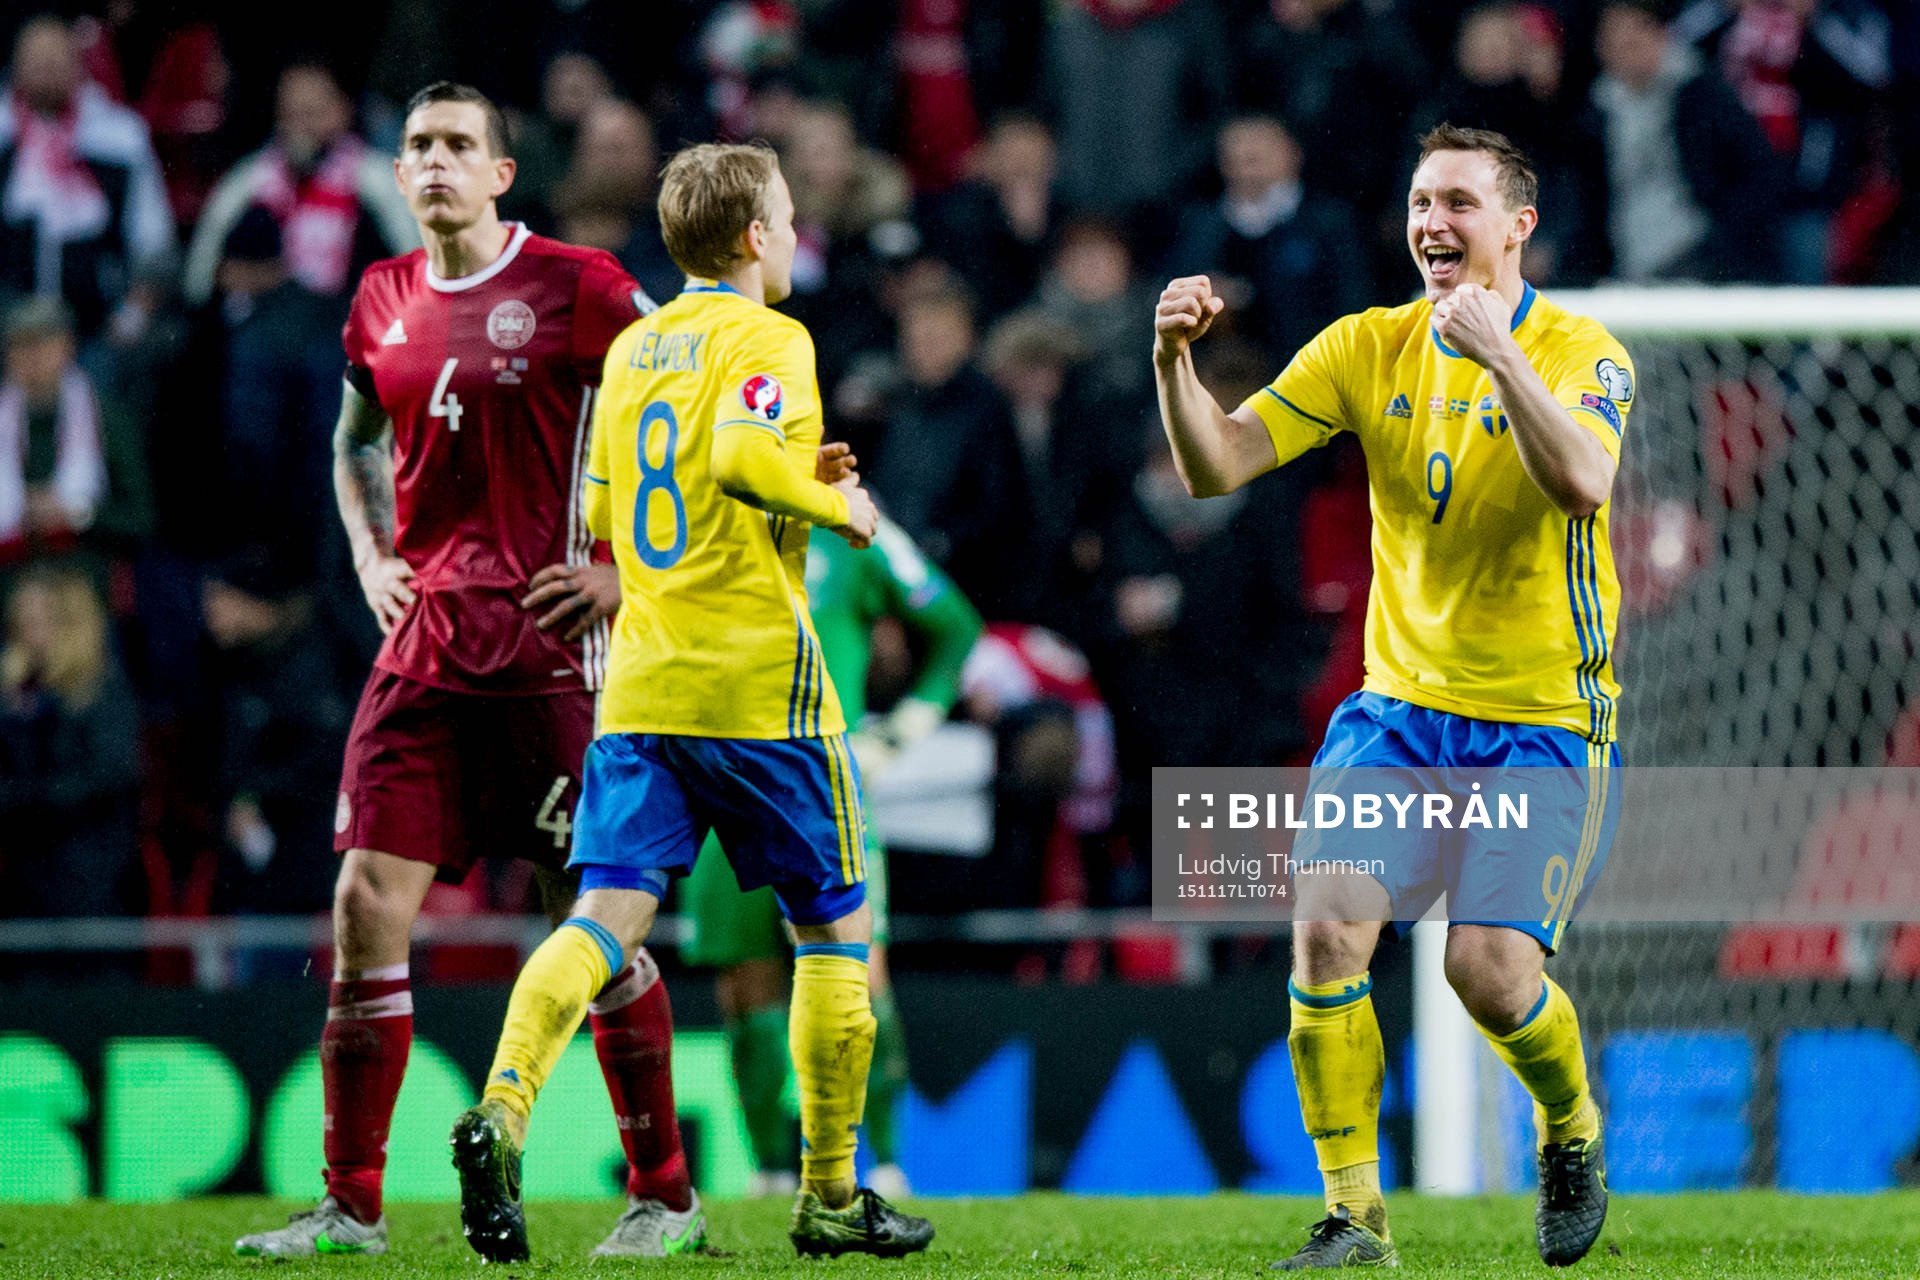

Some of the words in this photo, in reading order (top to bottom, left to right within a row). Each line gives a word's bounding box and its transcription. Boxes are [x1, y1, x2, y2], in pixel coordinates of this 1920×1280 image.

[428, 358, 463, 431] 4
[633, 401, 687, 570] 8
[1427, 451, 1453, 525] 9
[535, 775, 573, 848] 4
[1541, 855, 1569, 929] 9
